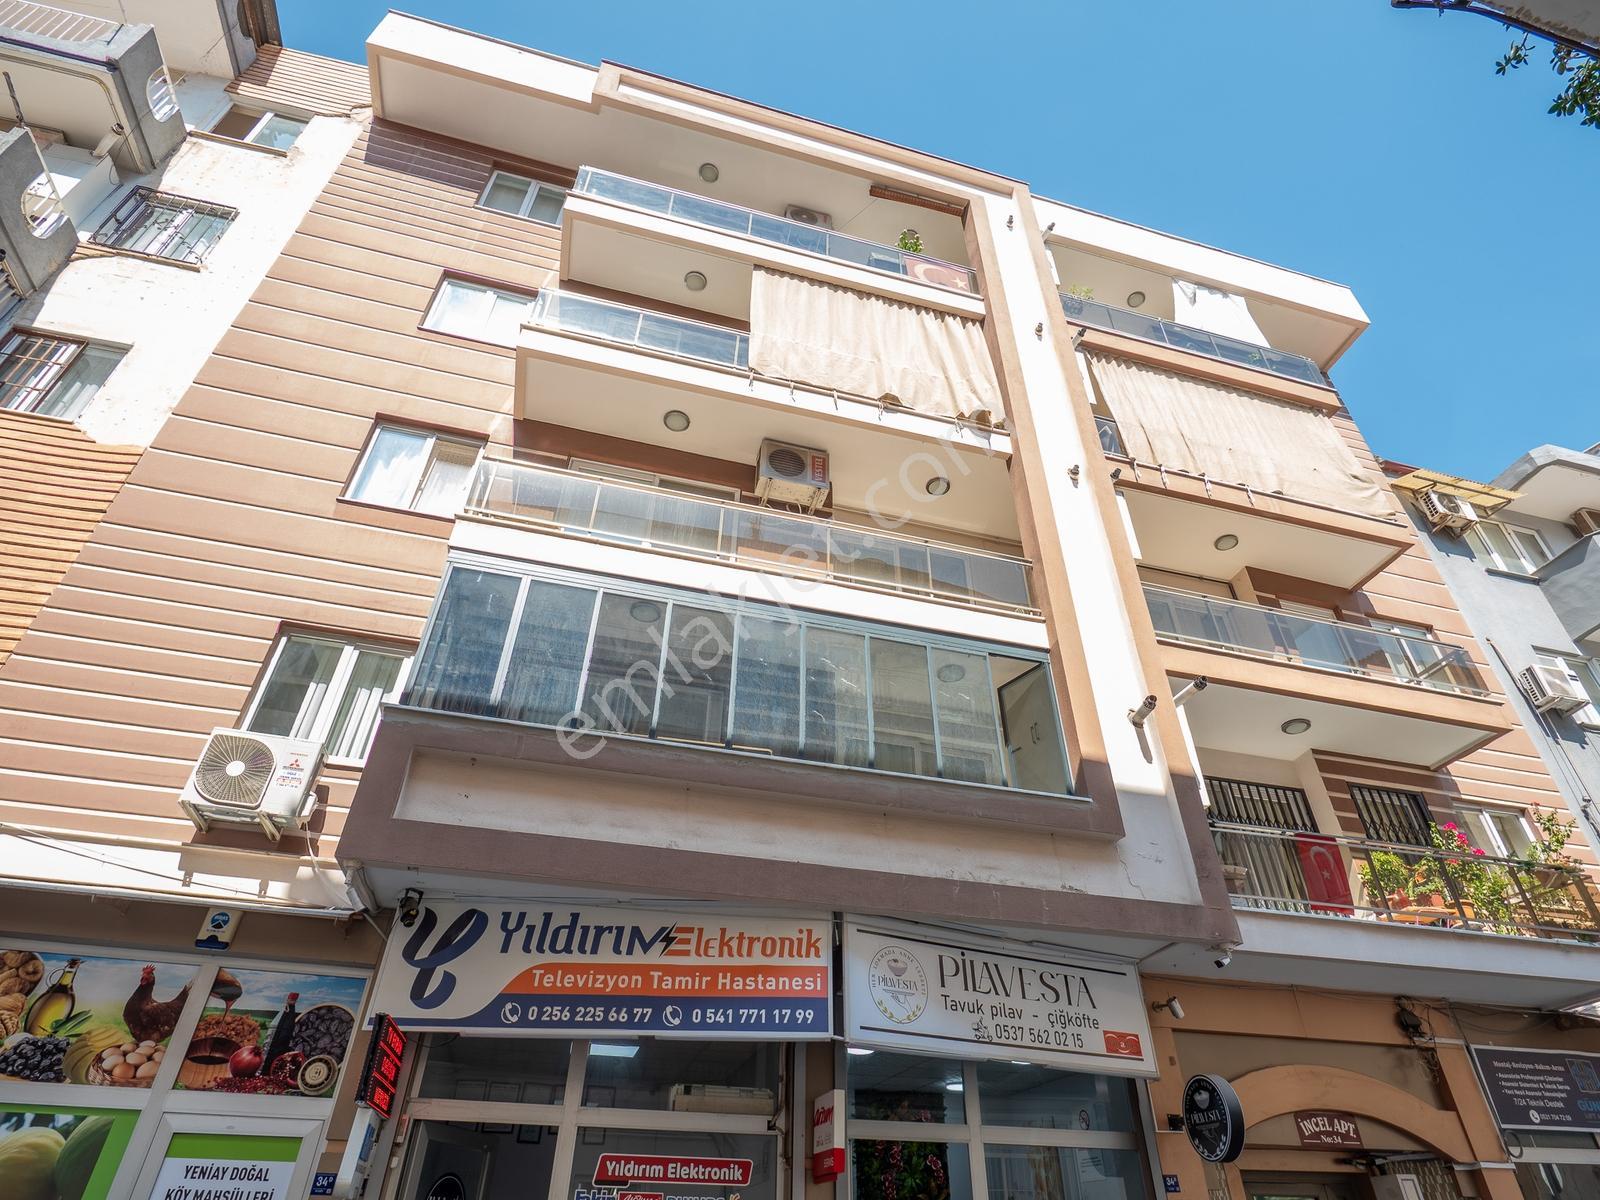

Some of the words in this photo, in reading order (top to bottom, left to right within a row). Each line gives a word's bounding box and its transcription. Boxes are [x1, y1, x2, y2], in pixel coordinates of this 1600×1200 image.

[532, 969, 642, 992] Televizyon
[650, 970, 711, 990] Tamir
[718, 972, 822, 991] Hastanesi
[937, 951, 1097, 1009] PİLAVESTA
[528, 1006, 538, 1021] 0
[541, 1006, 571, 1021] 256
[575, 1007, 604, 1021] 225
[607, 1007, 628, 1022] 66
[633, 1008, 652, 1023] 77
[692, 1009, 702, 1024] 0
[706, 1009, 733, 1024] 541
[739, 1009, 766, 1024] 771
[773, 1009, 791, 1024] 17
[795, 1009, 814, 1024] 99
[941, 994, 985, 1015] Tavuk
[990, 1002, 1023, 1020] pilav
[1047, 1009, 1100, 1030] çiğköfte
[995, 1023, 1024, 1042] 0537
[1029, 1028, 1051, 1045] 562
[1054, 1031, 1068, 1047] 02
[1071, 1032, 1084, 1049] 15
[1297, 1116, 1332, 1137] İNCEL
[184, 1163, 230, 1180] YENİAY
[230, 1165, 270, 1181] DOĞAL
[606, 1160, 664, 1178] Yıldırım
[667, 1162, 743, 1181] Elektronik
[165, 1186, 192, 1200] KÖY
